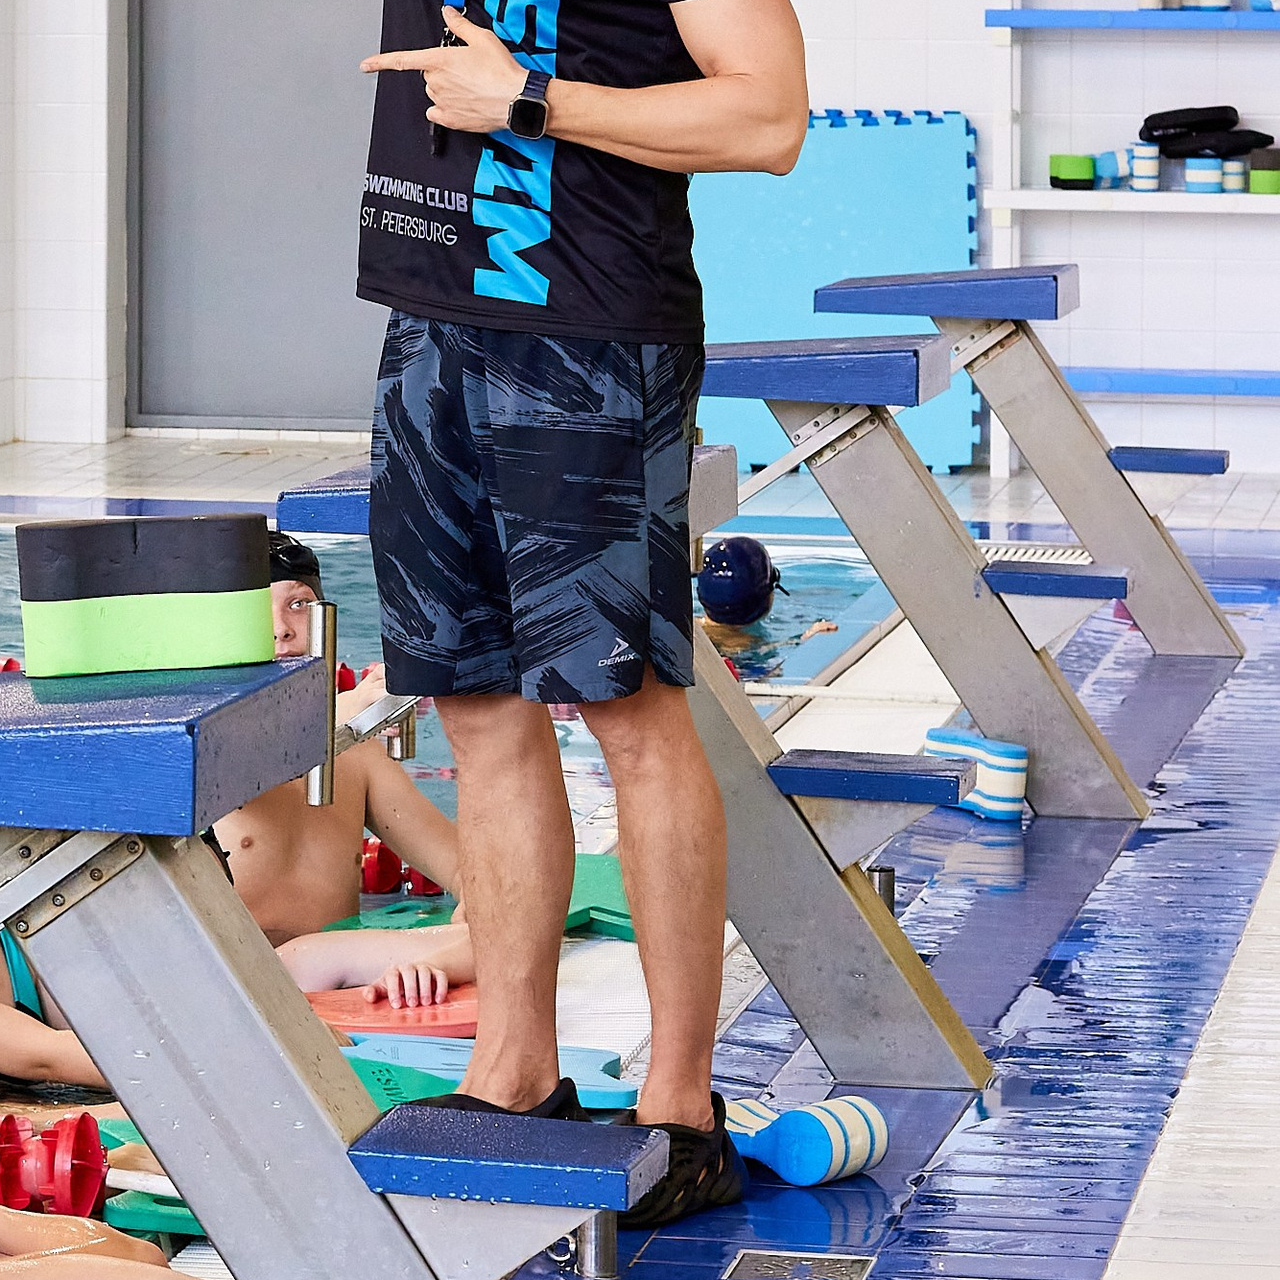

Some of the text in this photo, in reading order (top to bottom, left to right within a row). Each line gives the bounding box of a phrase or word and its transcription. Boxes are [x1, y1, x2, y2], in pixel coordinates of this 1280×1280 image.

[363, 173, 468, 212] SWIMMING CLUB
[361, 206, 458, 246] ST. PETERSBURG
[598, 652, 636, 667] DEMIX
